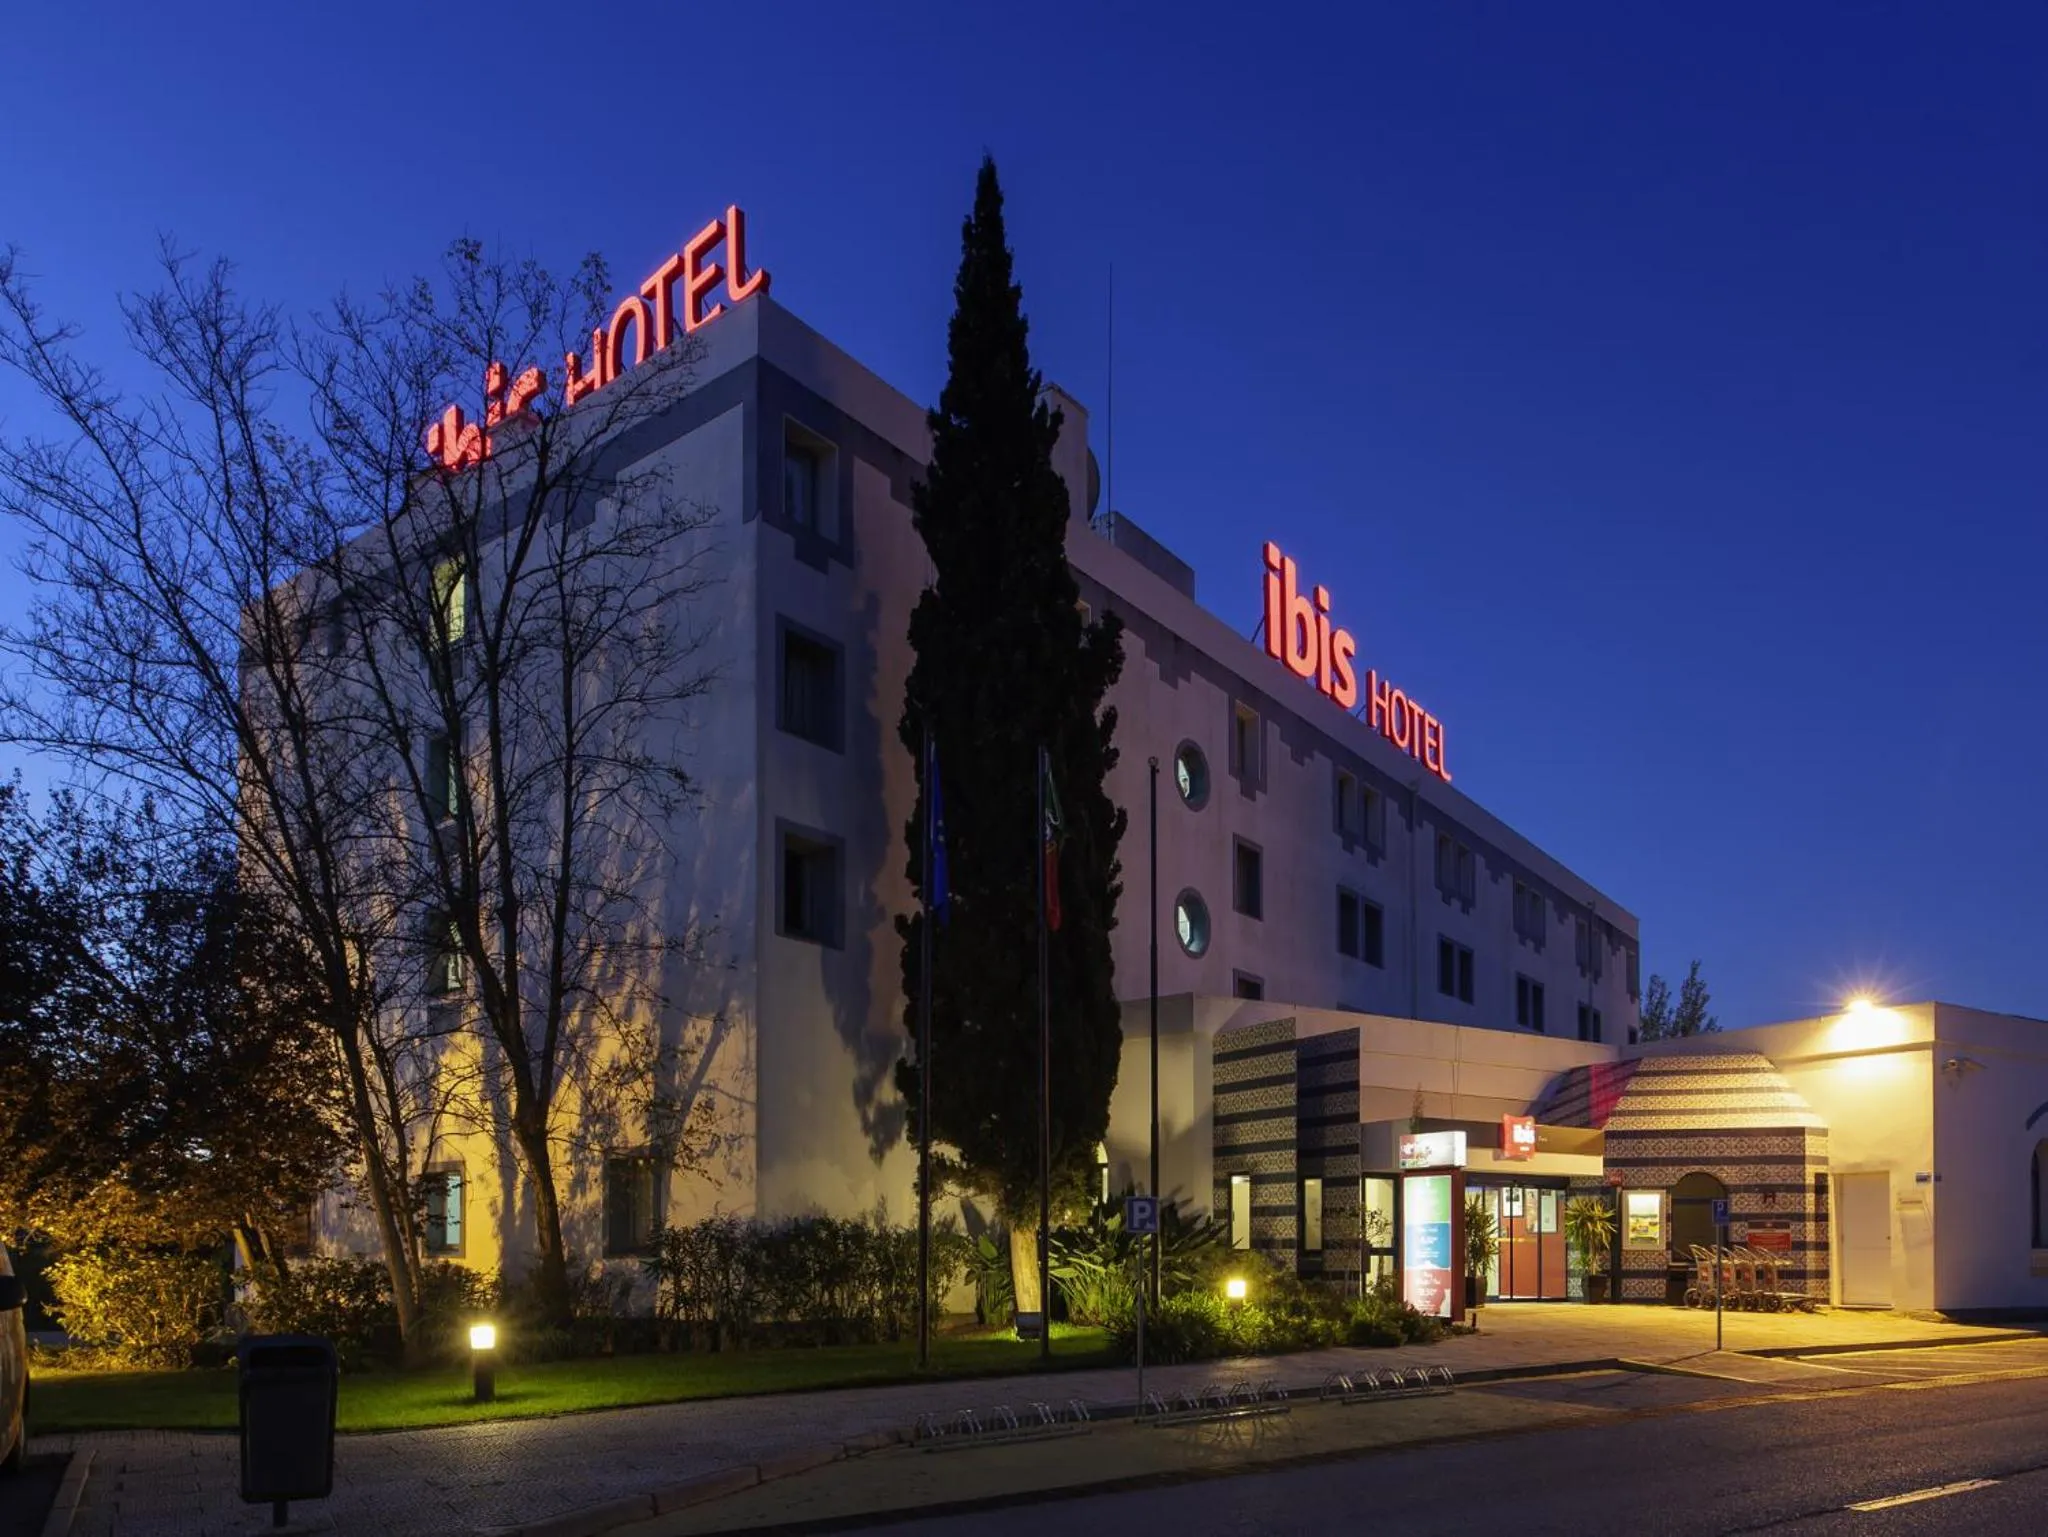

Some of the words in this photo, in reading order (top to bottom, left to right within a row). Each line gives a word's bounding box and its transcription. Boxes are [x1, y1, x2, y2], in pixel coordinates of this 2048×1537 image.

[566, 204, 771, 406] HOTEL
[1263, 541, 1357, 709] ibis
[1366, 668, 1452, 781] HOTEL
[1132, 1200, 1151, 1229] P
